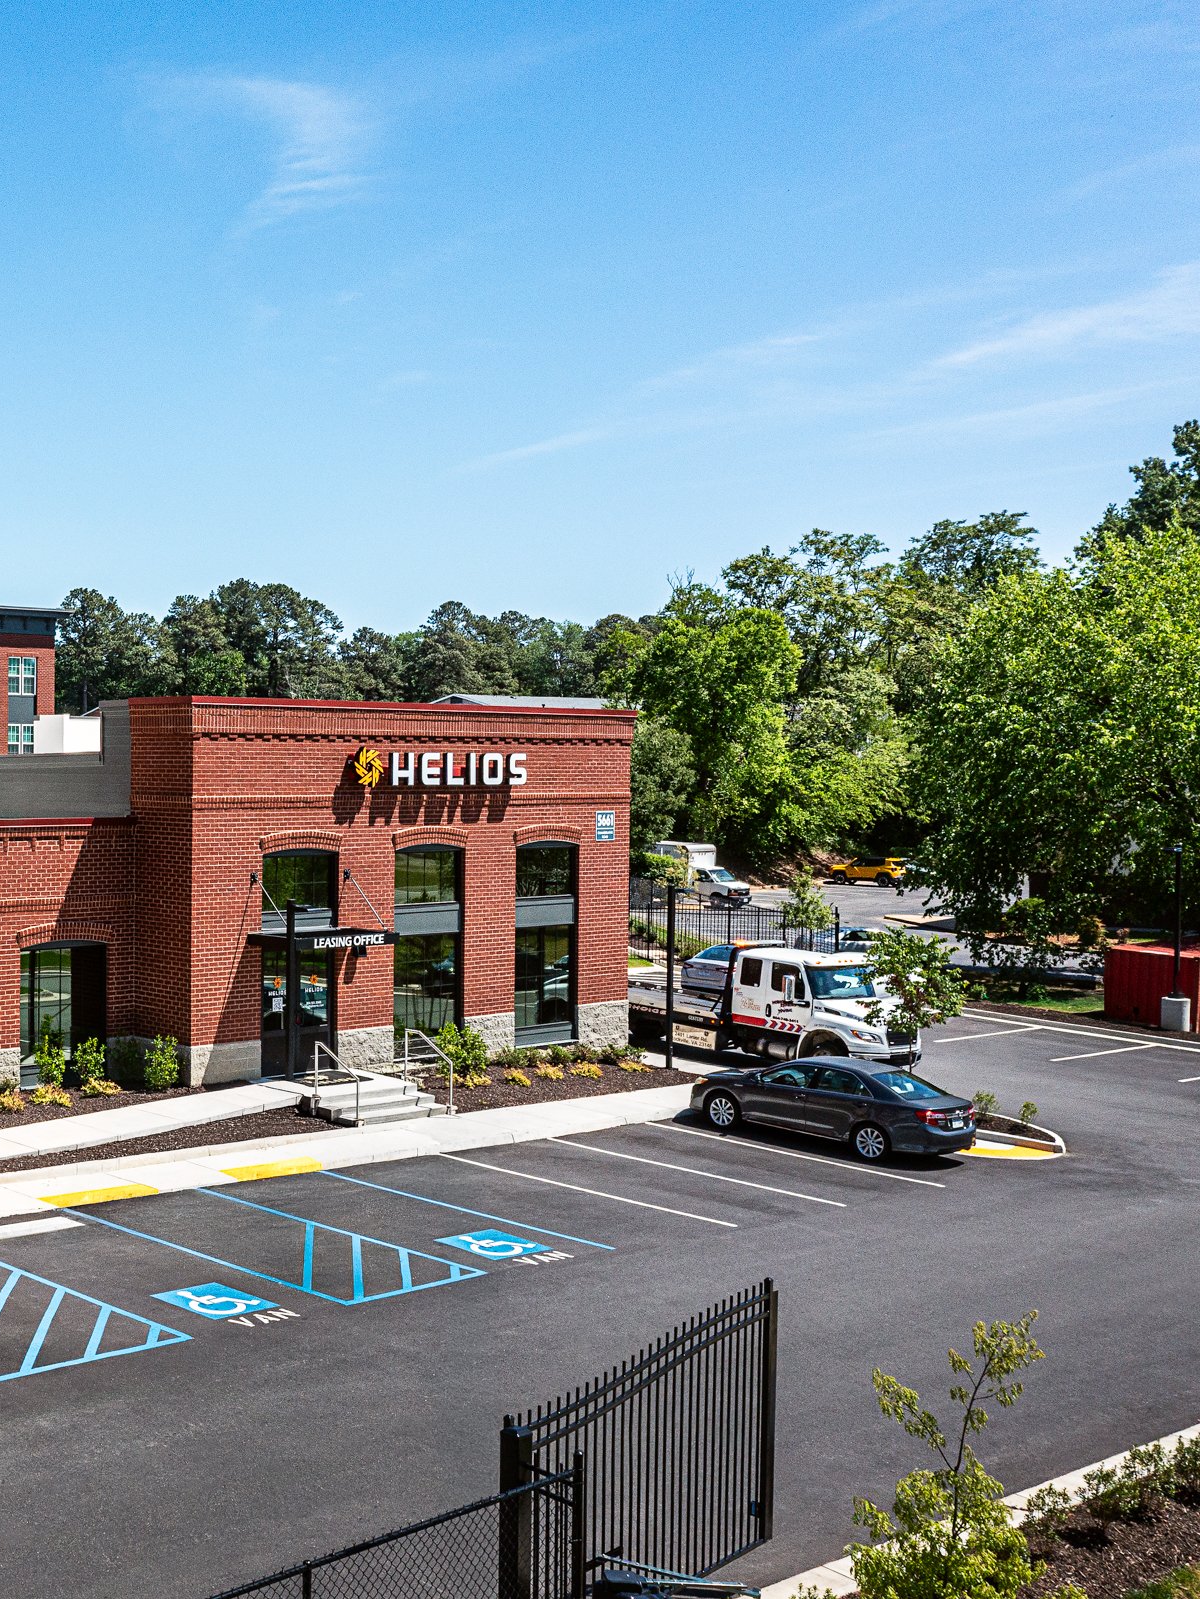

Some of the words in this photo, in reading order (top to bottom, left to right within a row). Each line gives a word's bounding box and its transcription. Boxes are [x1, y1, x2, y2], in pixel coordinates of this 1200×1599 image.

[391, 752, 527, 786] HELIOS
[597, 813, 614, 827] 5661
[313, 936, 352, 949] LEASING
[353, 933, 385, 946] OFFICE
[512, 1250, 575, 1265] VAN
[227, 1308, 301, 1328] VAN
